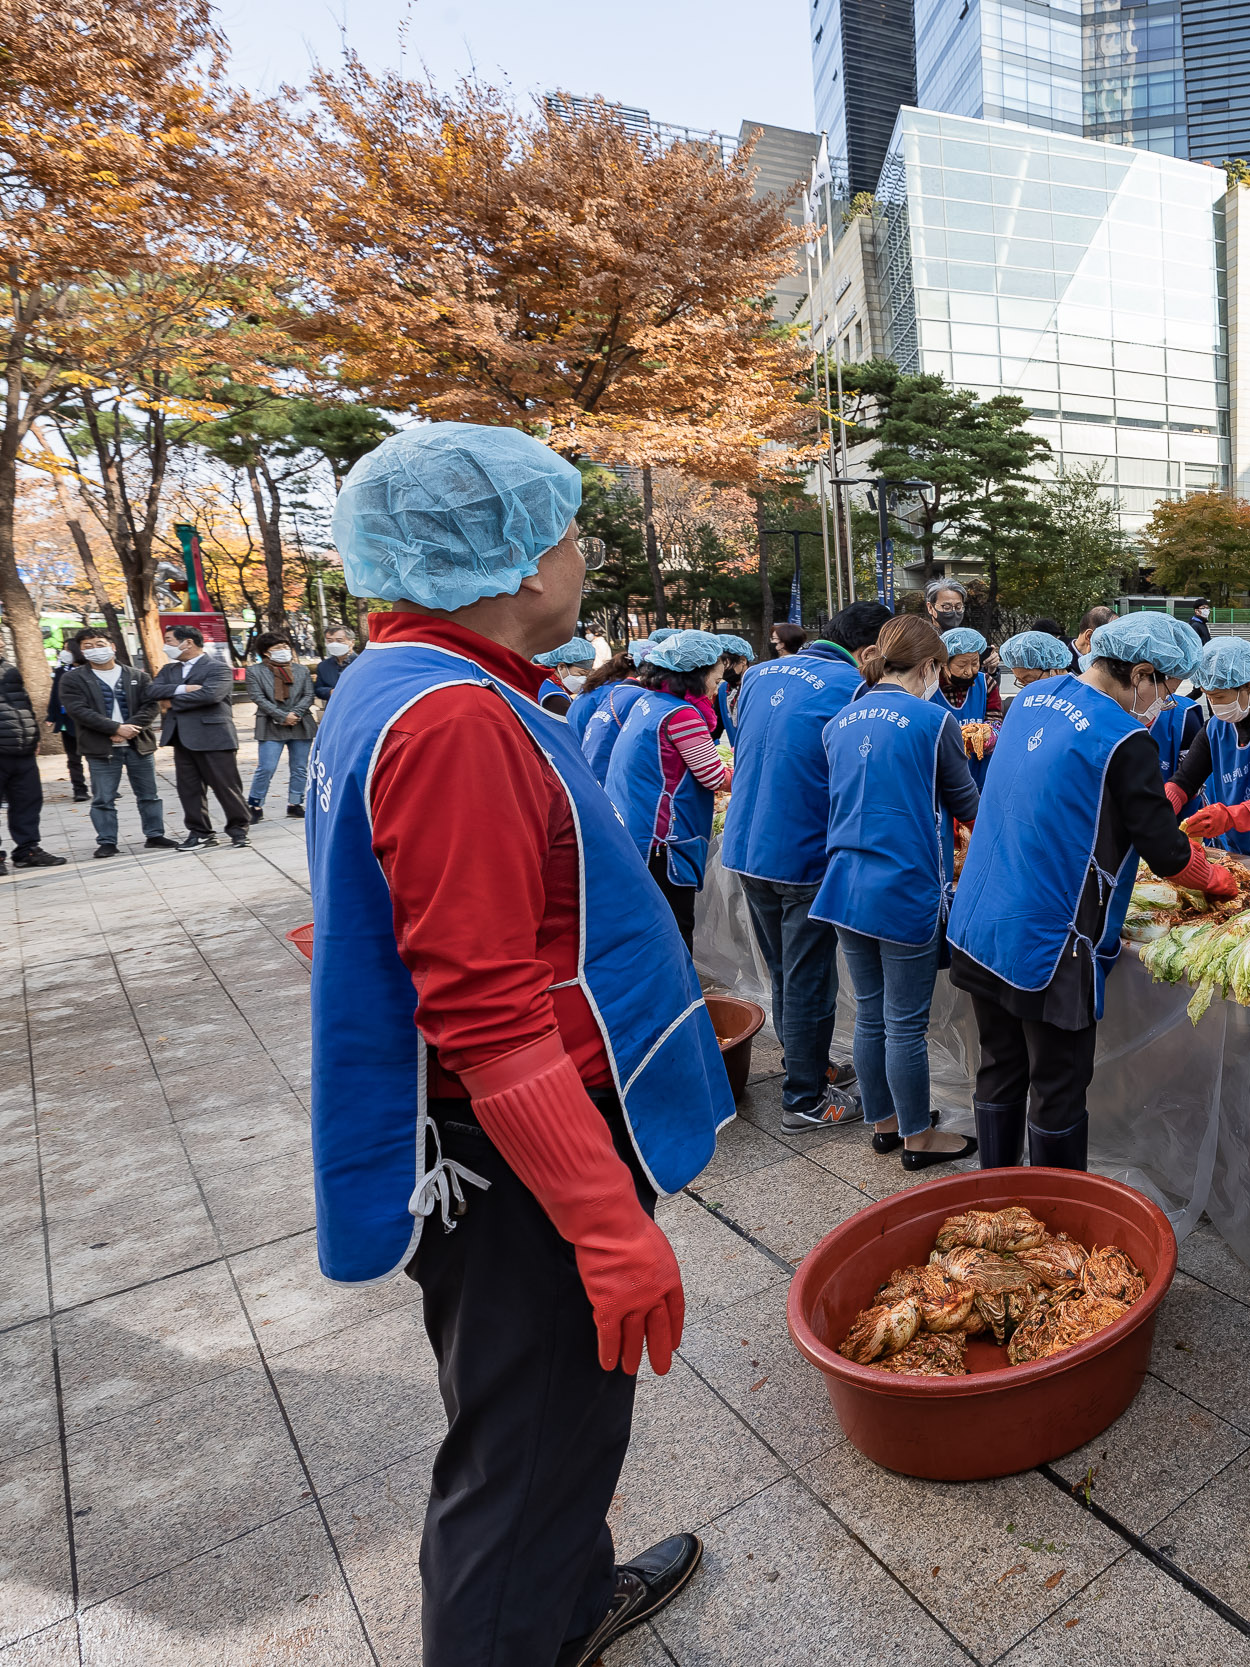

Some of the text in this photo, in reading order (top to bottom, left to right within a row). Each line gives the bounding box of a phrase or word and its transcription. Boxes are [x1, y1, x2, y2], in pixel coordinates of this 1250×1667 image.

[759, 665, 826, 690] 바르게살기운동
[838, 707, 911, 729] 바르게살기운동
[1022, 694, 1091, 732] 바르게살기운동
